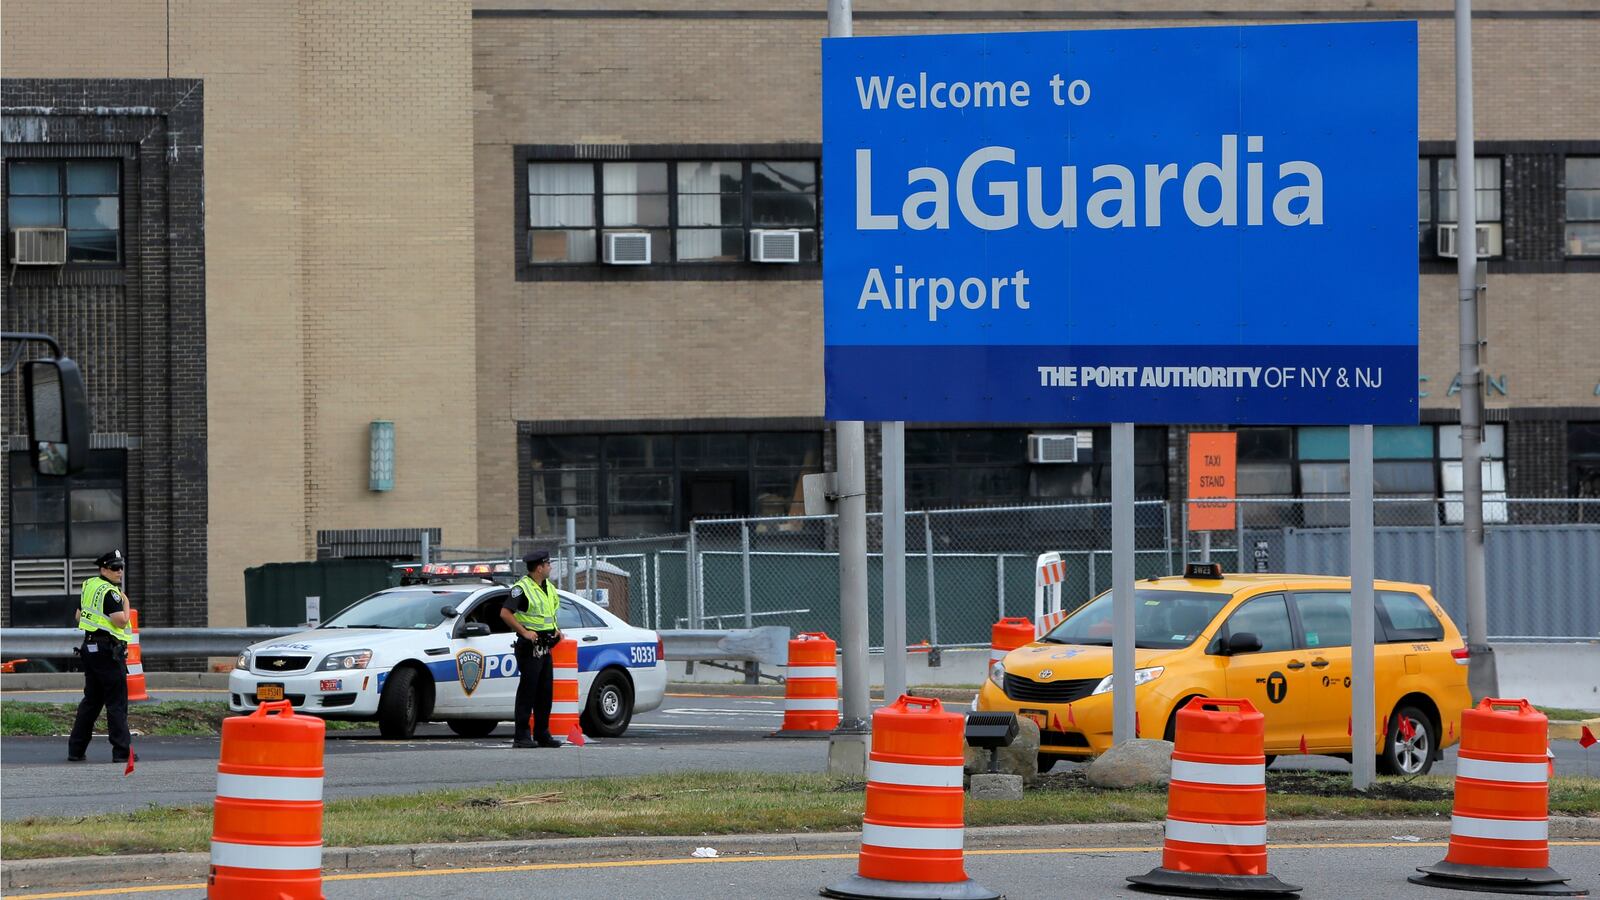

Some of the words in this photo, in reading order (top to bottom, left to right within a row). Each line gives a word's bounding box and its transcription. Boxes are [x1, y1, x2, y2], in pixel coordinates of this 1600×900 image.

[856, 72, 1030, 109] Welcome
[1050, 74, 1090, 106] to
[856, 134, 1324, 231] LaGuardia
[857, 265, 1030, 321] Airport
[1038, 366, 1077, 388] THE
[1081, 366, 1137, 388] PORT
[1140, 366, 1262, 388] AUTHORITY
[1264, 366, 1296, 388] OF
[1300, 367, 1331, 388] NY
[1336, 367, 1349, 388] &
[1355, 367, 1382, 388] NJ
[1204, 455, 1221, 466] TAXI
[1200, 475, 1225, 488] STAND
[630, 646, 657, 664] 50331
